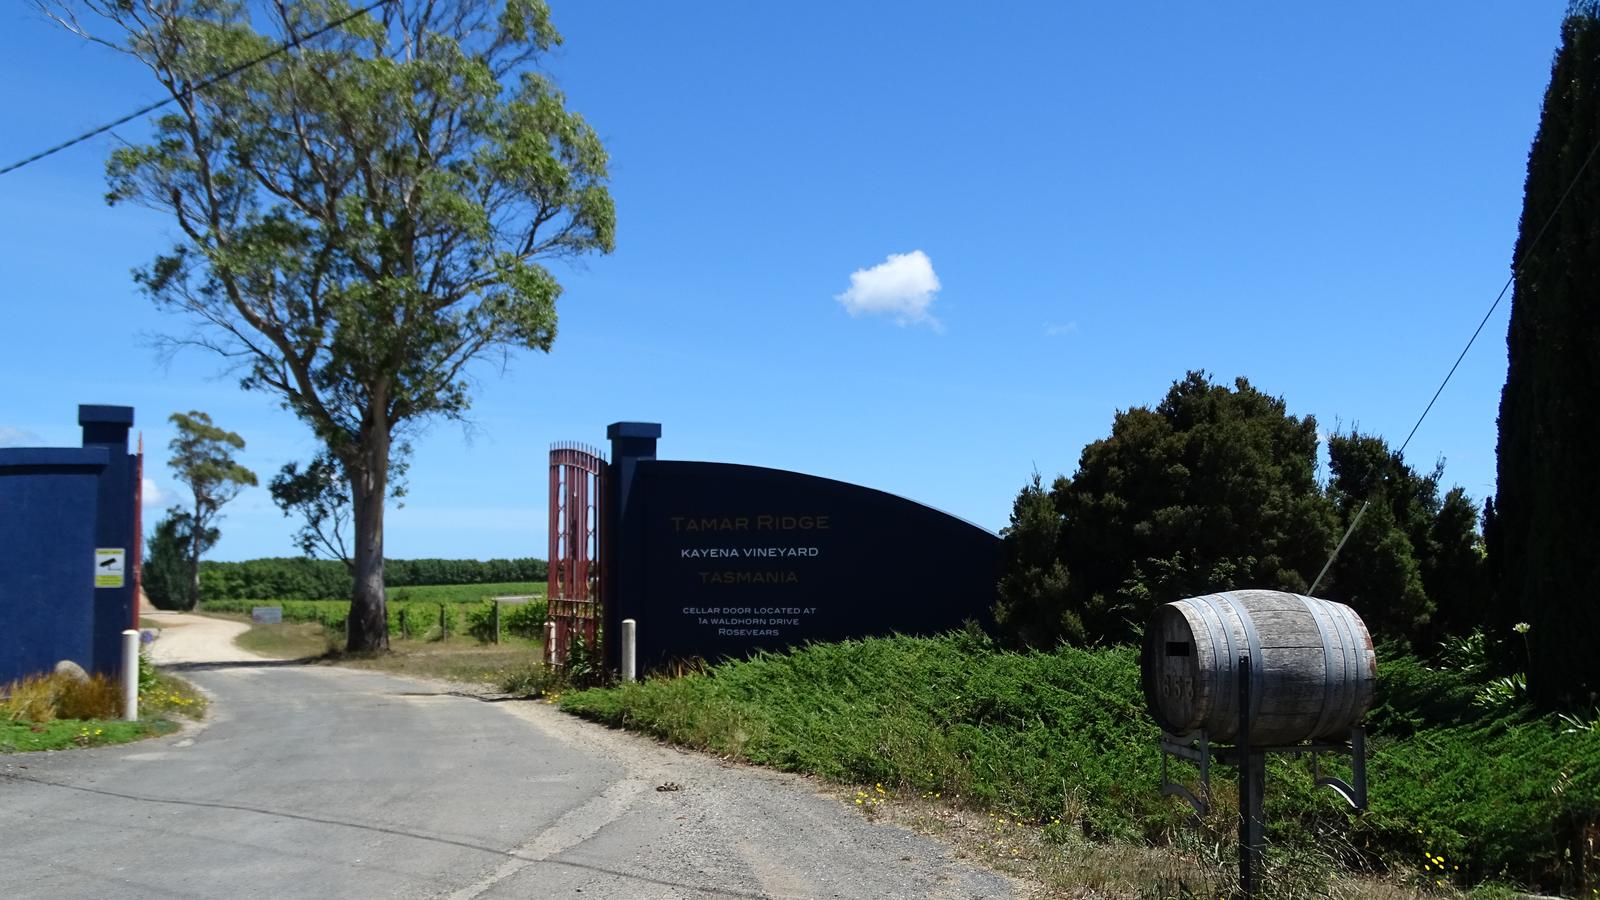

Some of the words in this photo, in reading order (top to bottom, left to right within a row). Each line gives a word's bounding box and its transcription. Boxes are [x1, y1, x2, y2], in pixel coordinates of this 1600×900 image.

[670, 516, 749, 531] TAMAR
[757, 515, 831, 530] RIDGE
[681, 548, 739, 558] KAYENA
[743, 547, 819, 557] VINEYARD
[699, 571, 799, 584] TASMANIA
[682, 607, 720, 615] CELLAR
[722, 607, 751, 615] DOOR
[754, 607, 801, 615] LOCATED
[803, 607, 817, 615] AT
[698, 617, 708, 625] 1A
[711, 617, 767, 625] WALDHORN
[769, 617, 800, 625] DRIVE
[718, 628, 780, 637] ROSEVEARS
